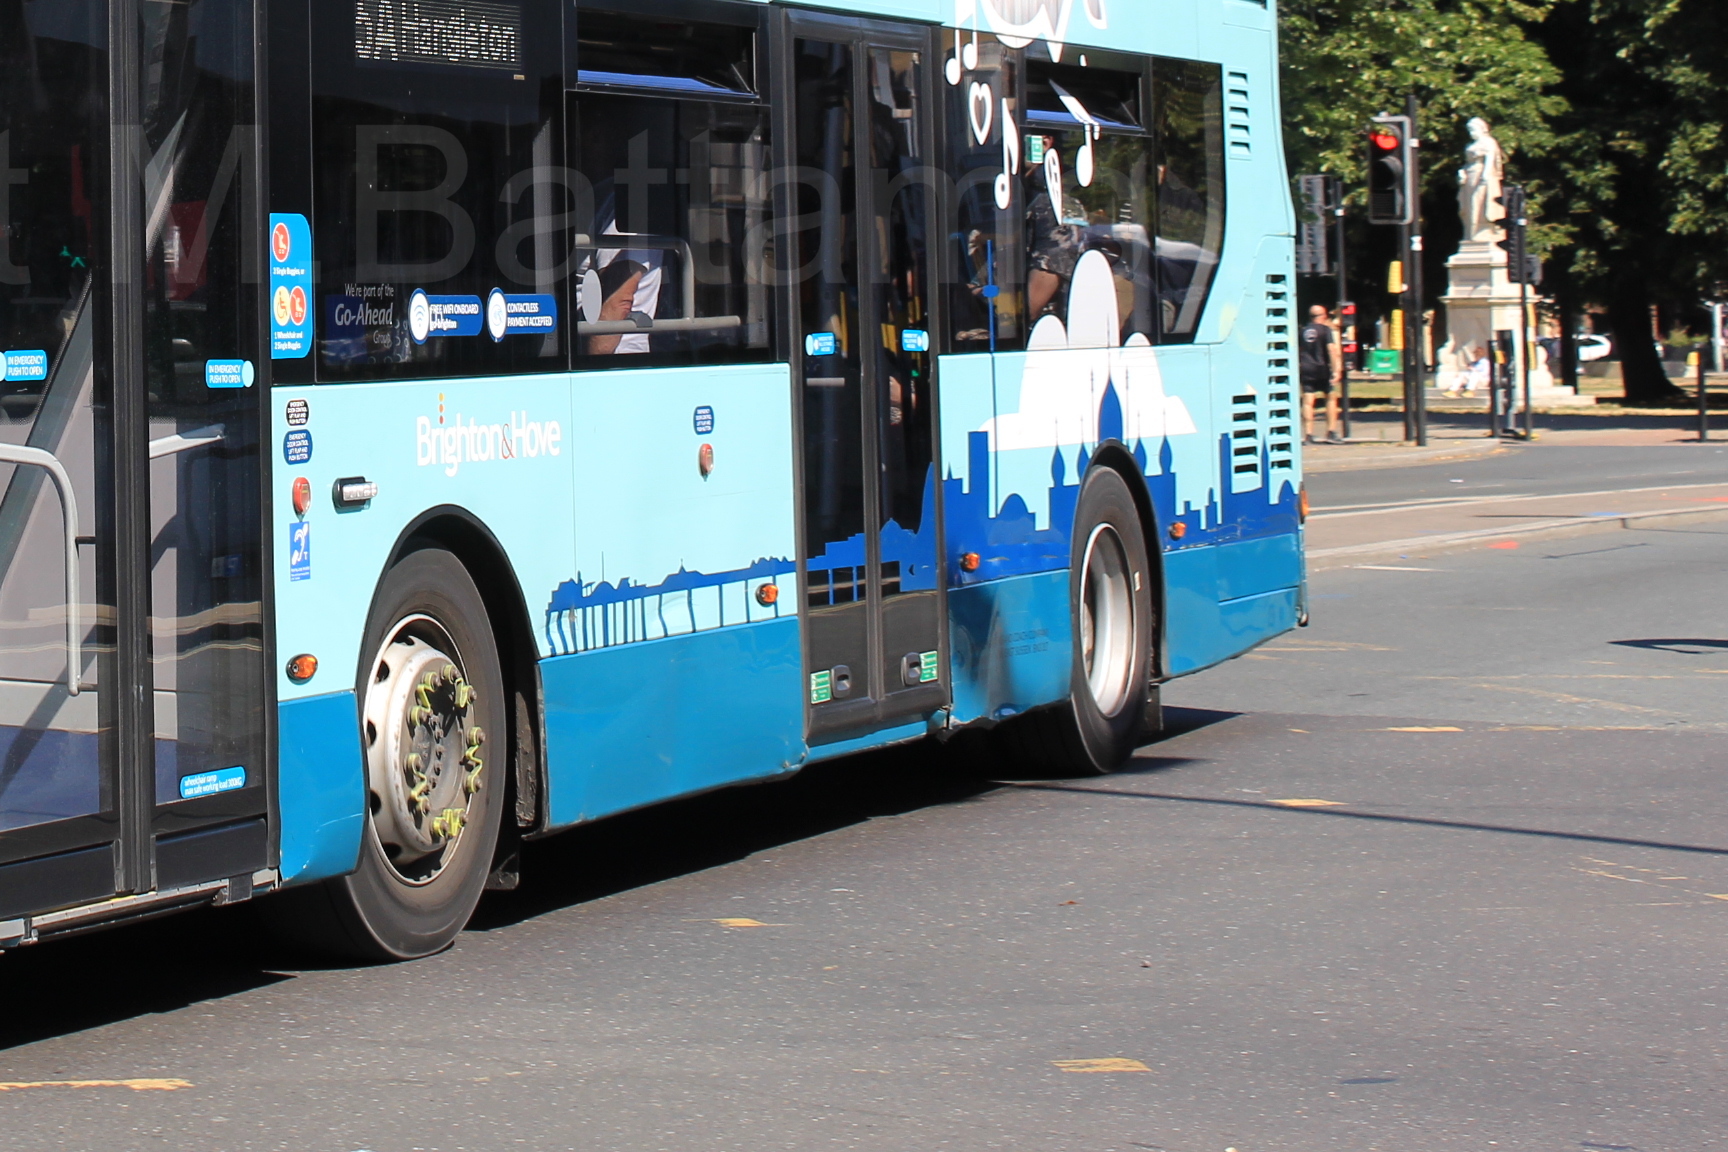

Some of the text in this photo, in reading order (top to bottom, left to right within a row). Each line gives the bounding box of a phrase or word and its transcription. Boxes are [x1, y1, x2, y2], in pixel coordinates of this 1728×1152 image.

[401, 3, 516, 62] Hangleton
[345, 283, 394, 300] We're part of the
[454, 303, 479, 315] ONBOARD
[507, 302, 540, 313] CONTACTLESS
[335, 302, 394, 326] Go-Ahead
[507, 315, 553, 327] PAYMENT ACCEPTED
[14, 355, 44, 366] EMERGENCY
[7, 366, 22, 376] PUSH
[29, 365, 44, 376] OPEN
[214, 364, 241, 374] EMERGENCY
[209, 374, 221, 384] PUSH
[228, 374, 241, 384] OPEN
[416, 393, 561, 477] Brighton&Hove
